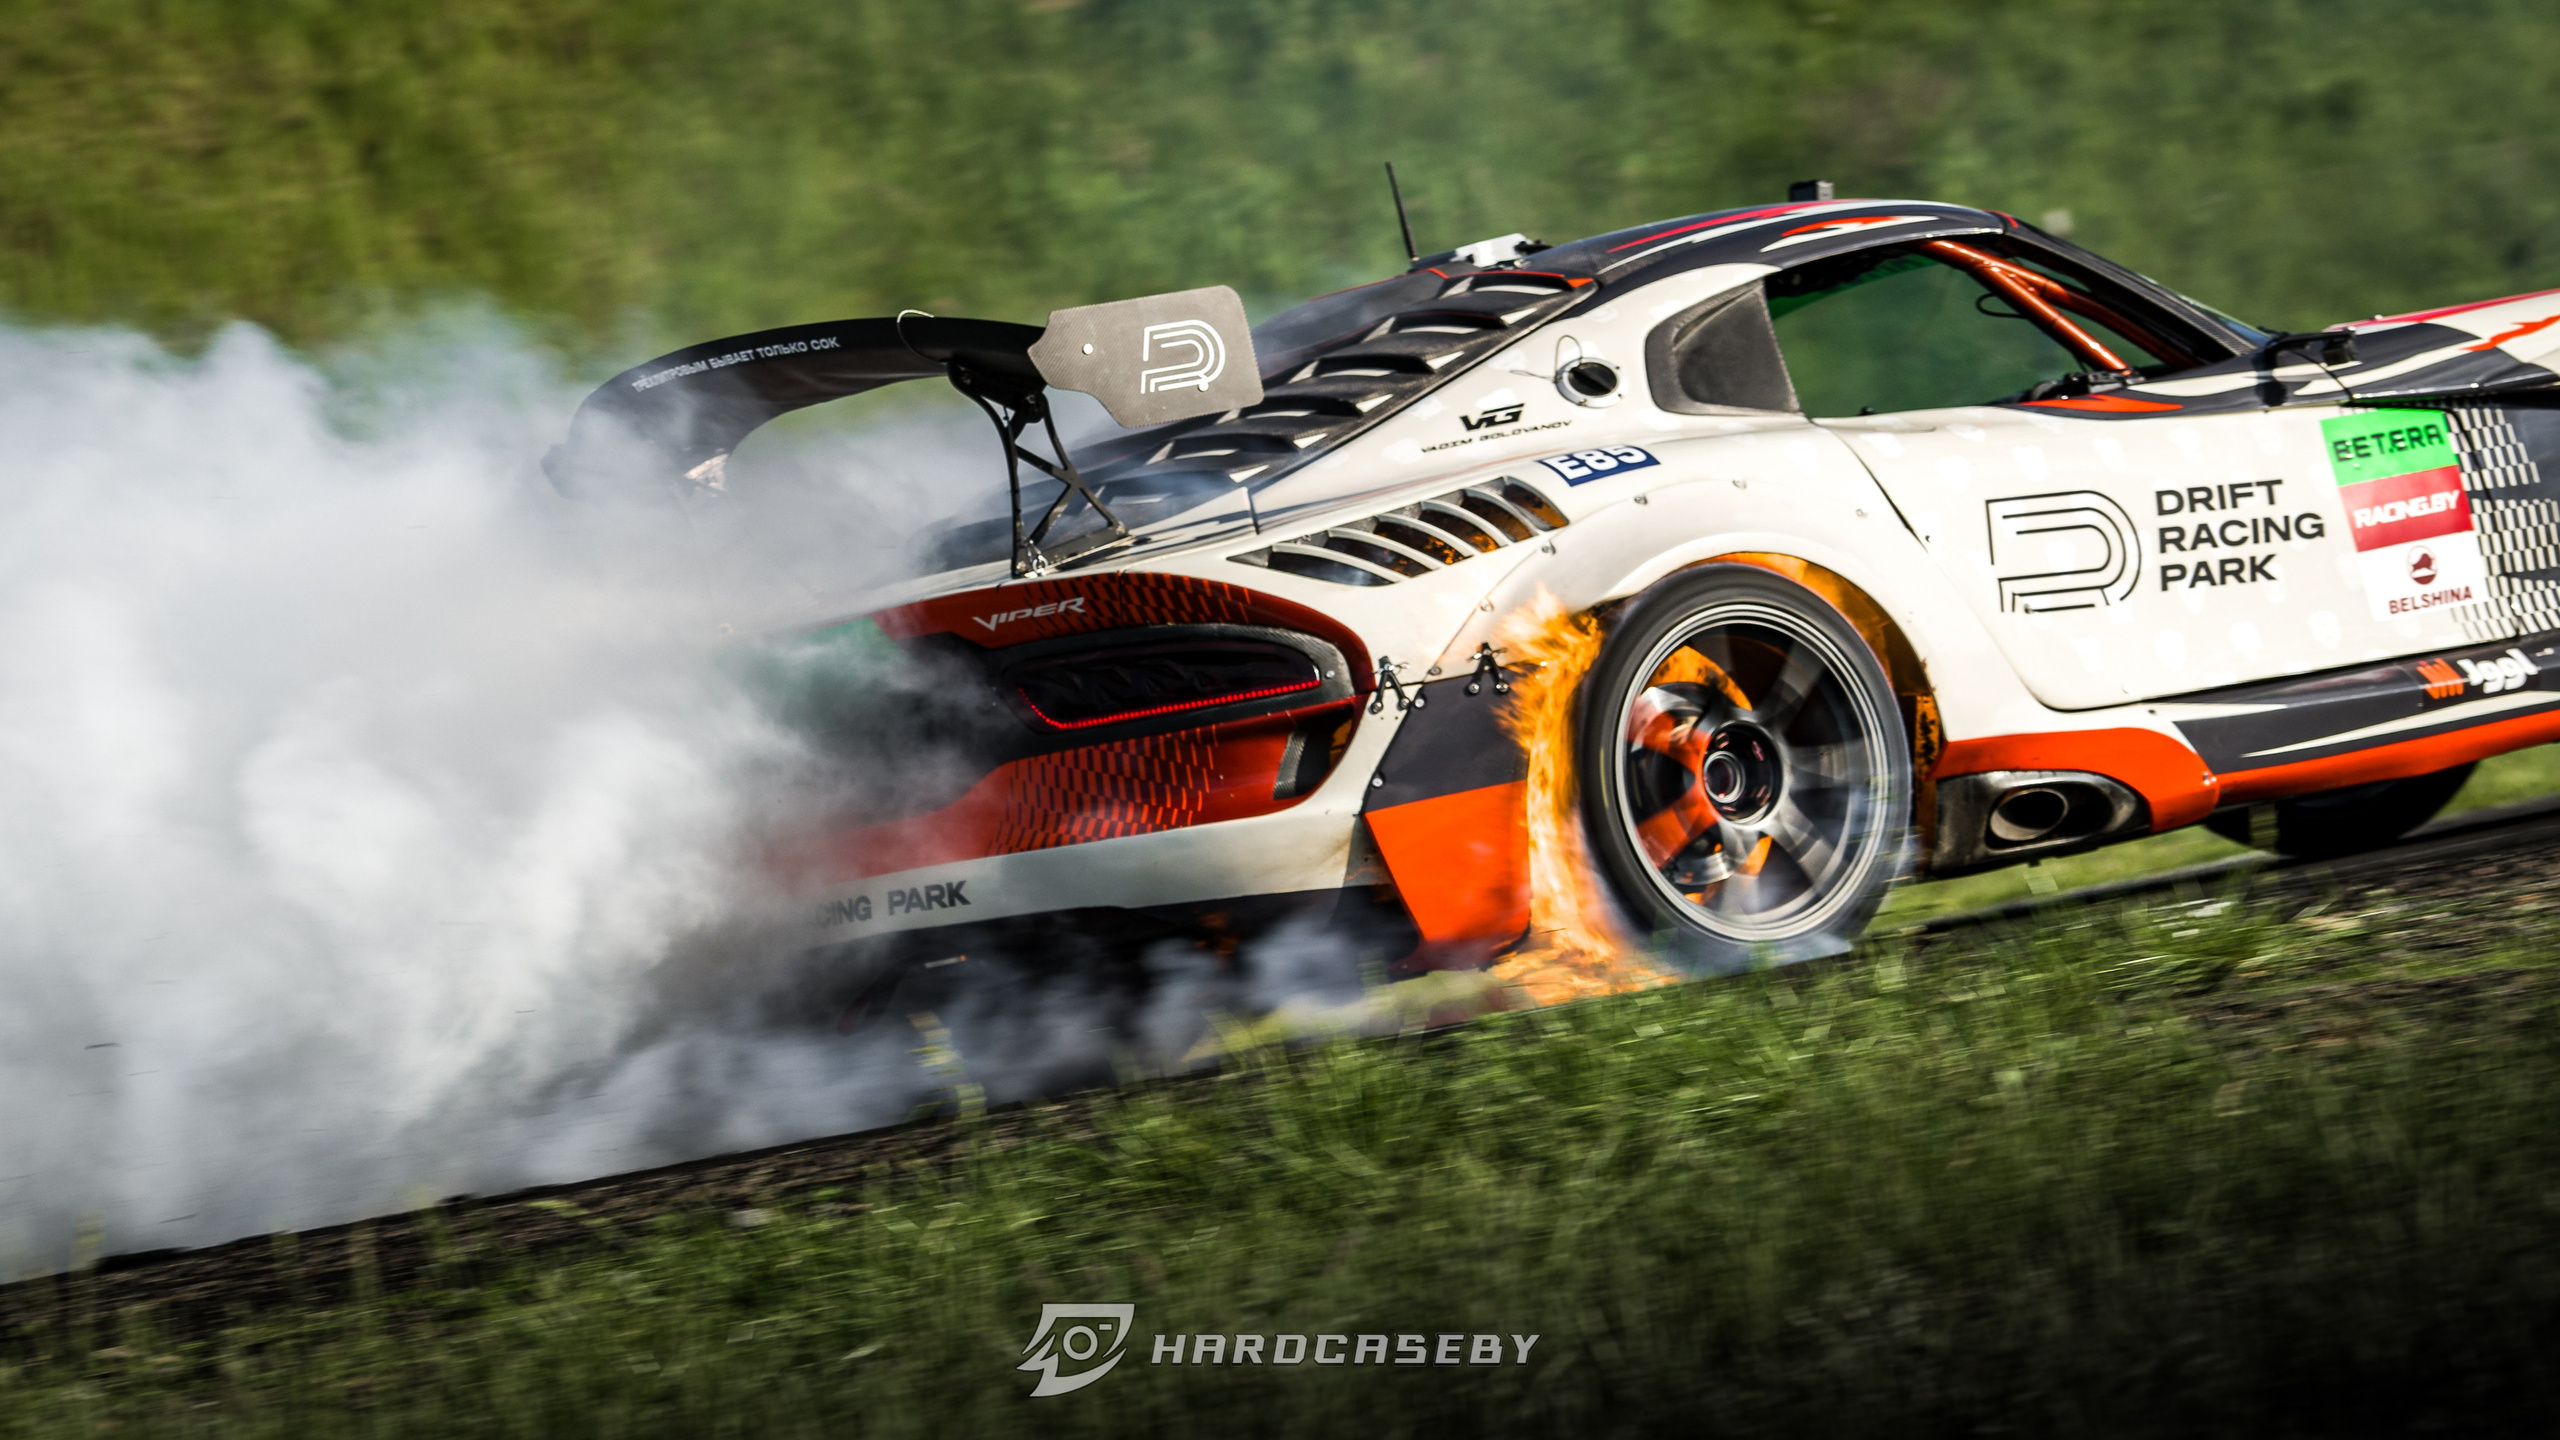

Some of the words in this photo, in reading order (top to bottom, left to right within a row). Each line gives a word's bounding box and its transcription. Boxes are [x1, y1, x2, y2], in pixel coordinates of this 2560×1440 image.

[708, 349, 756, 370] БЫВАЕТ
[756, 341, 808, 359] ТОЛЬКО
[810, 336, 840, 350] СОК
[1421, 438, 1473, 453] VADIM
[1542, 445, 1648, 480] E85
[2155, 479, 2283, 516] DRIFT
[2158, 512, 2325, 553] RACING
[2160, 553, 2277, 591] PARK
[971, 597, 1087, 632] VIPER
[2389, 586, 2473, 614] BELSHINA
[887, 880, 972, 916] PARK
